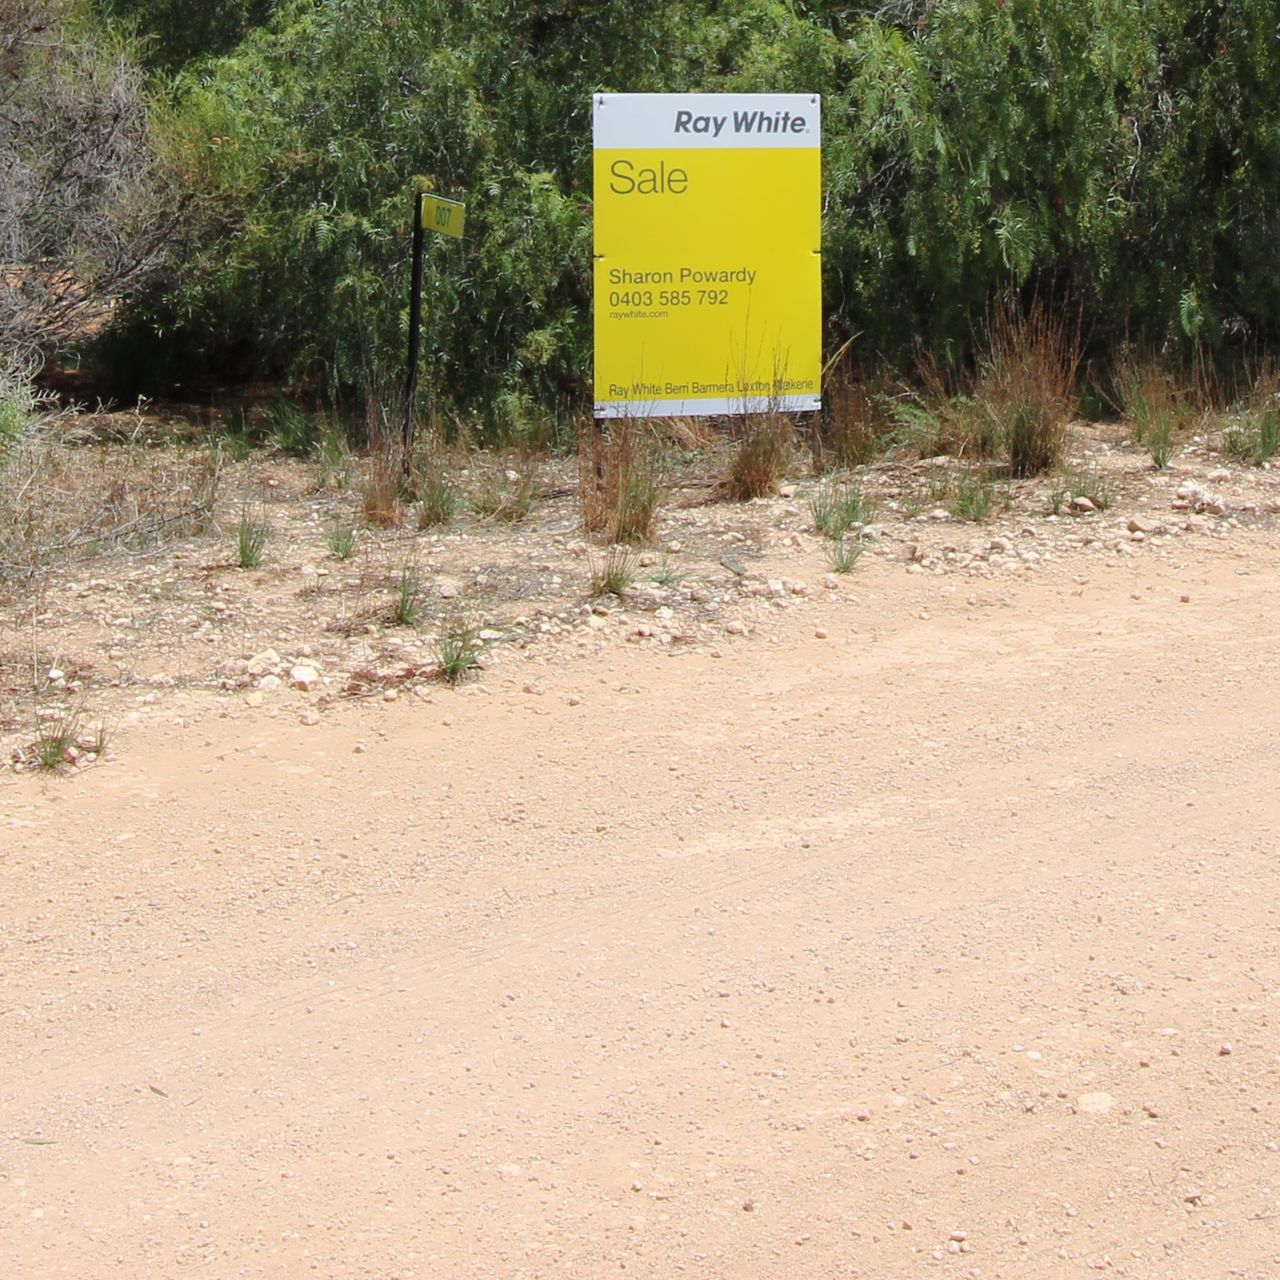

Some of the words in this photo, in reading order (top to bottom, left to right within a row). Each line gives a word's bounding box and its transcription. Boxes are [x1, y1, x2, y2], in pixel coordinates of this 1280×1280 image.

[674, 110, 727, 138] Ray
[733, 110, 807, 134] White
[610, 160, 688, 194] Sale
[609, 269, 673, 285] Sharon
[680, 267, 756, 286] Powardy
[609, 291, 653, 307] 0403
[659, 290, 691, 306] 585
[697, 289, 728, 305] 792
[609, 309, 669, 320] raywhite.com
[609, 383, 629, 399] Ray
[632, 382, 662, 395] White
[692, 381, 734, 394] Barmera
